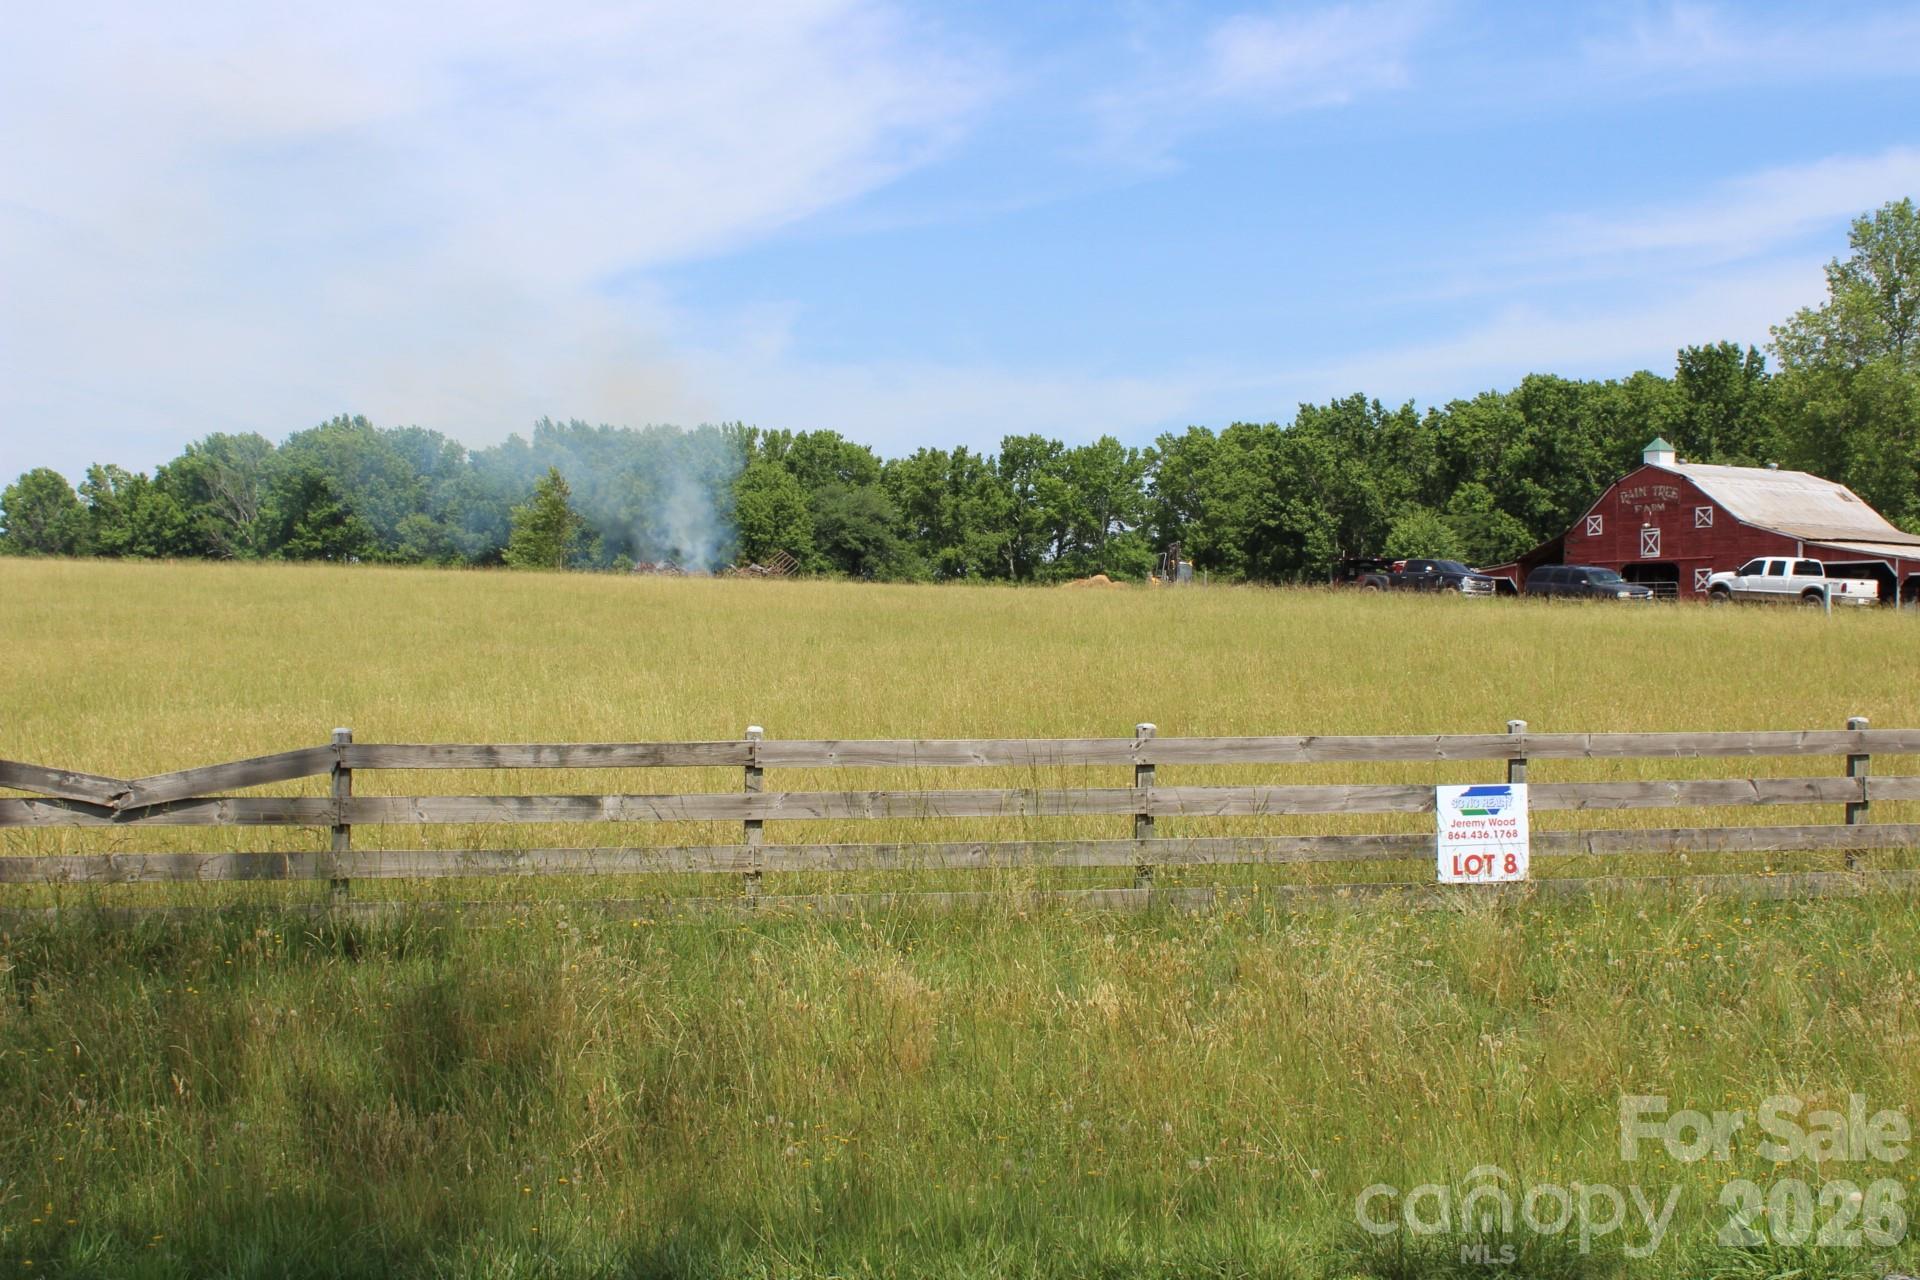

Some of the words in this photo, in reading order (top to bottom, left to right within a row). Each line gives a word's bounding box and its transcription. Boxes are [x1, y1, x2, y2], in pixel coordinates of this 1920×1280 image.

[1620, 487, 1647, 504] RAIN
[1652, 484, 1679, 501] TREE
[1634, 503, 1665, 512] FARM
[1450, 819, 1485, 828] Jeremy
[1488, 817, 1516, 826] Wood
[1448, 829, 1518, 840] 864.436.1768
[1453, 854, 1495, 876] LOT
[1503, 853, 1518, 874] 8
